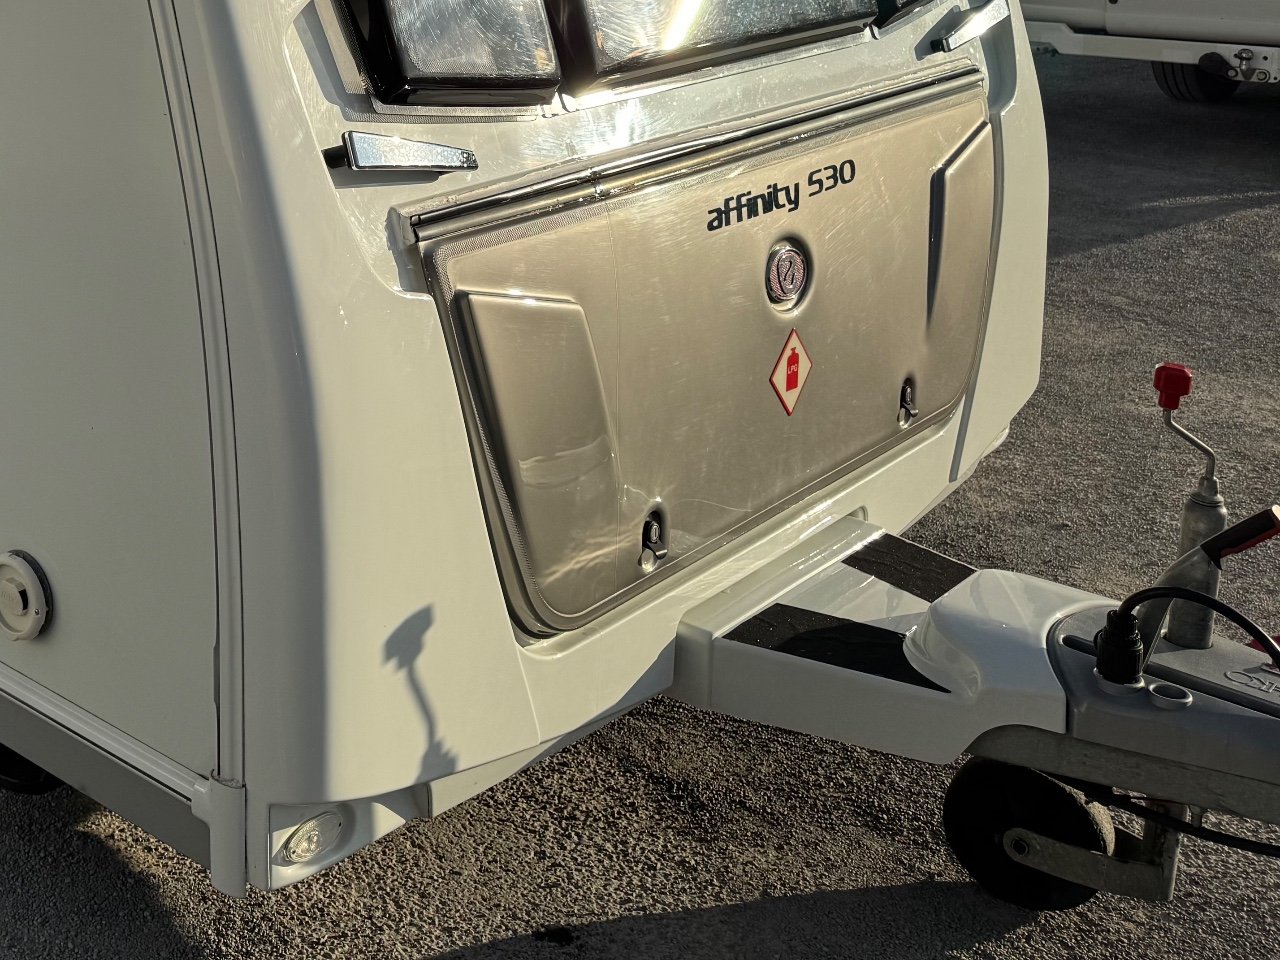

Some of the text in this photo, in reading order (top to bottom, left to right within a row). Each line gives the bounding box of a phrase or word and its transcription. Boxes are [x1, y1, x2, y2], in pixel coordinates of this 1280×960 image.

[706, 159, 856, 231] affinity 530
[787, 363, 798, 375] LPG
